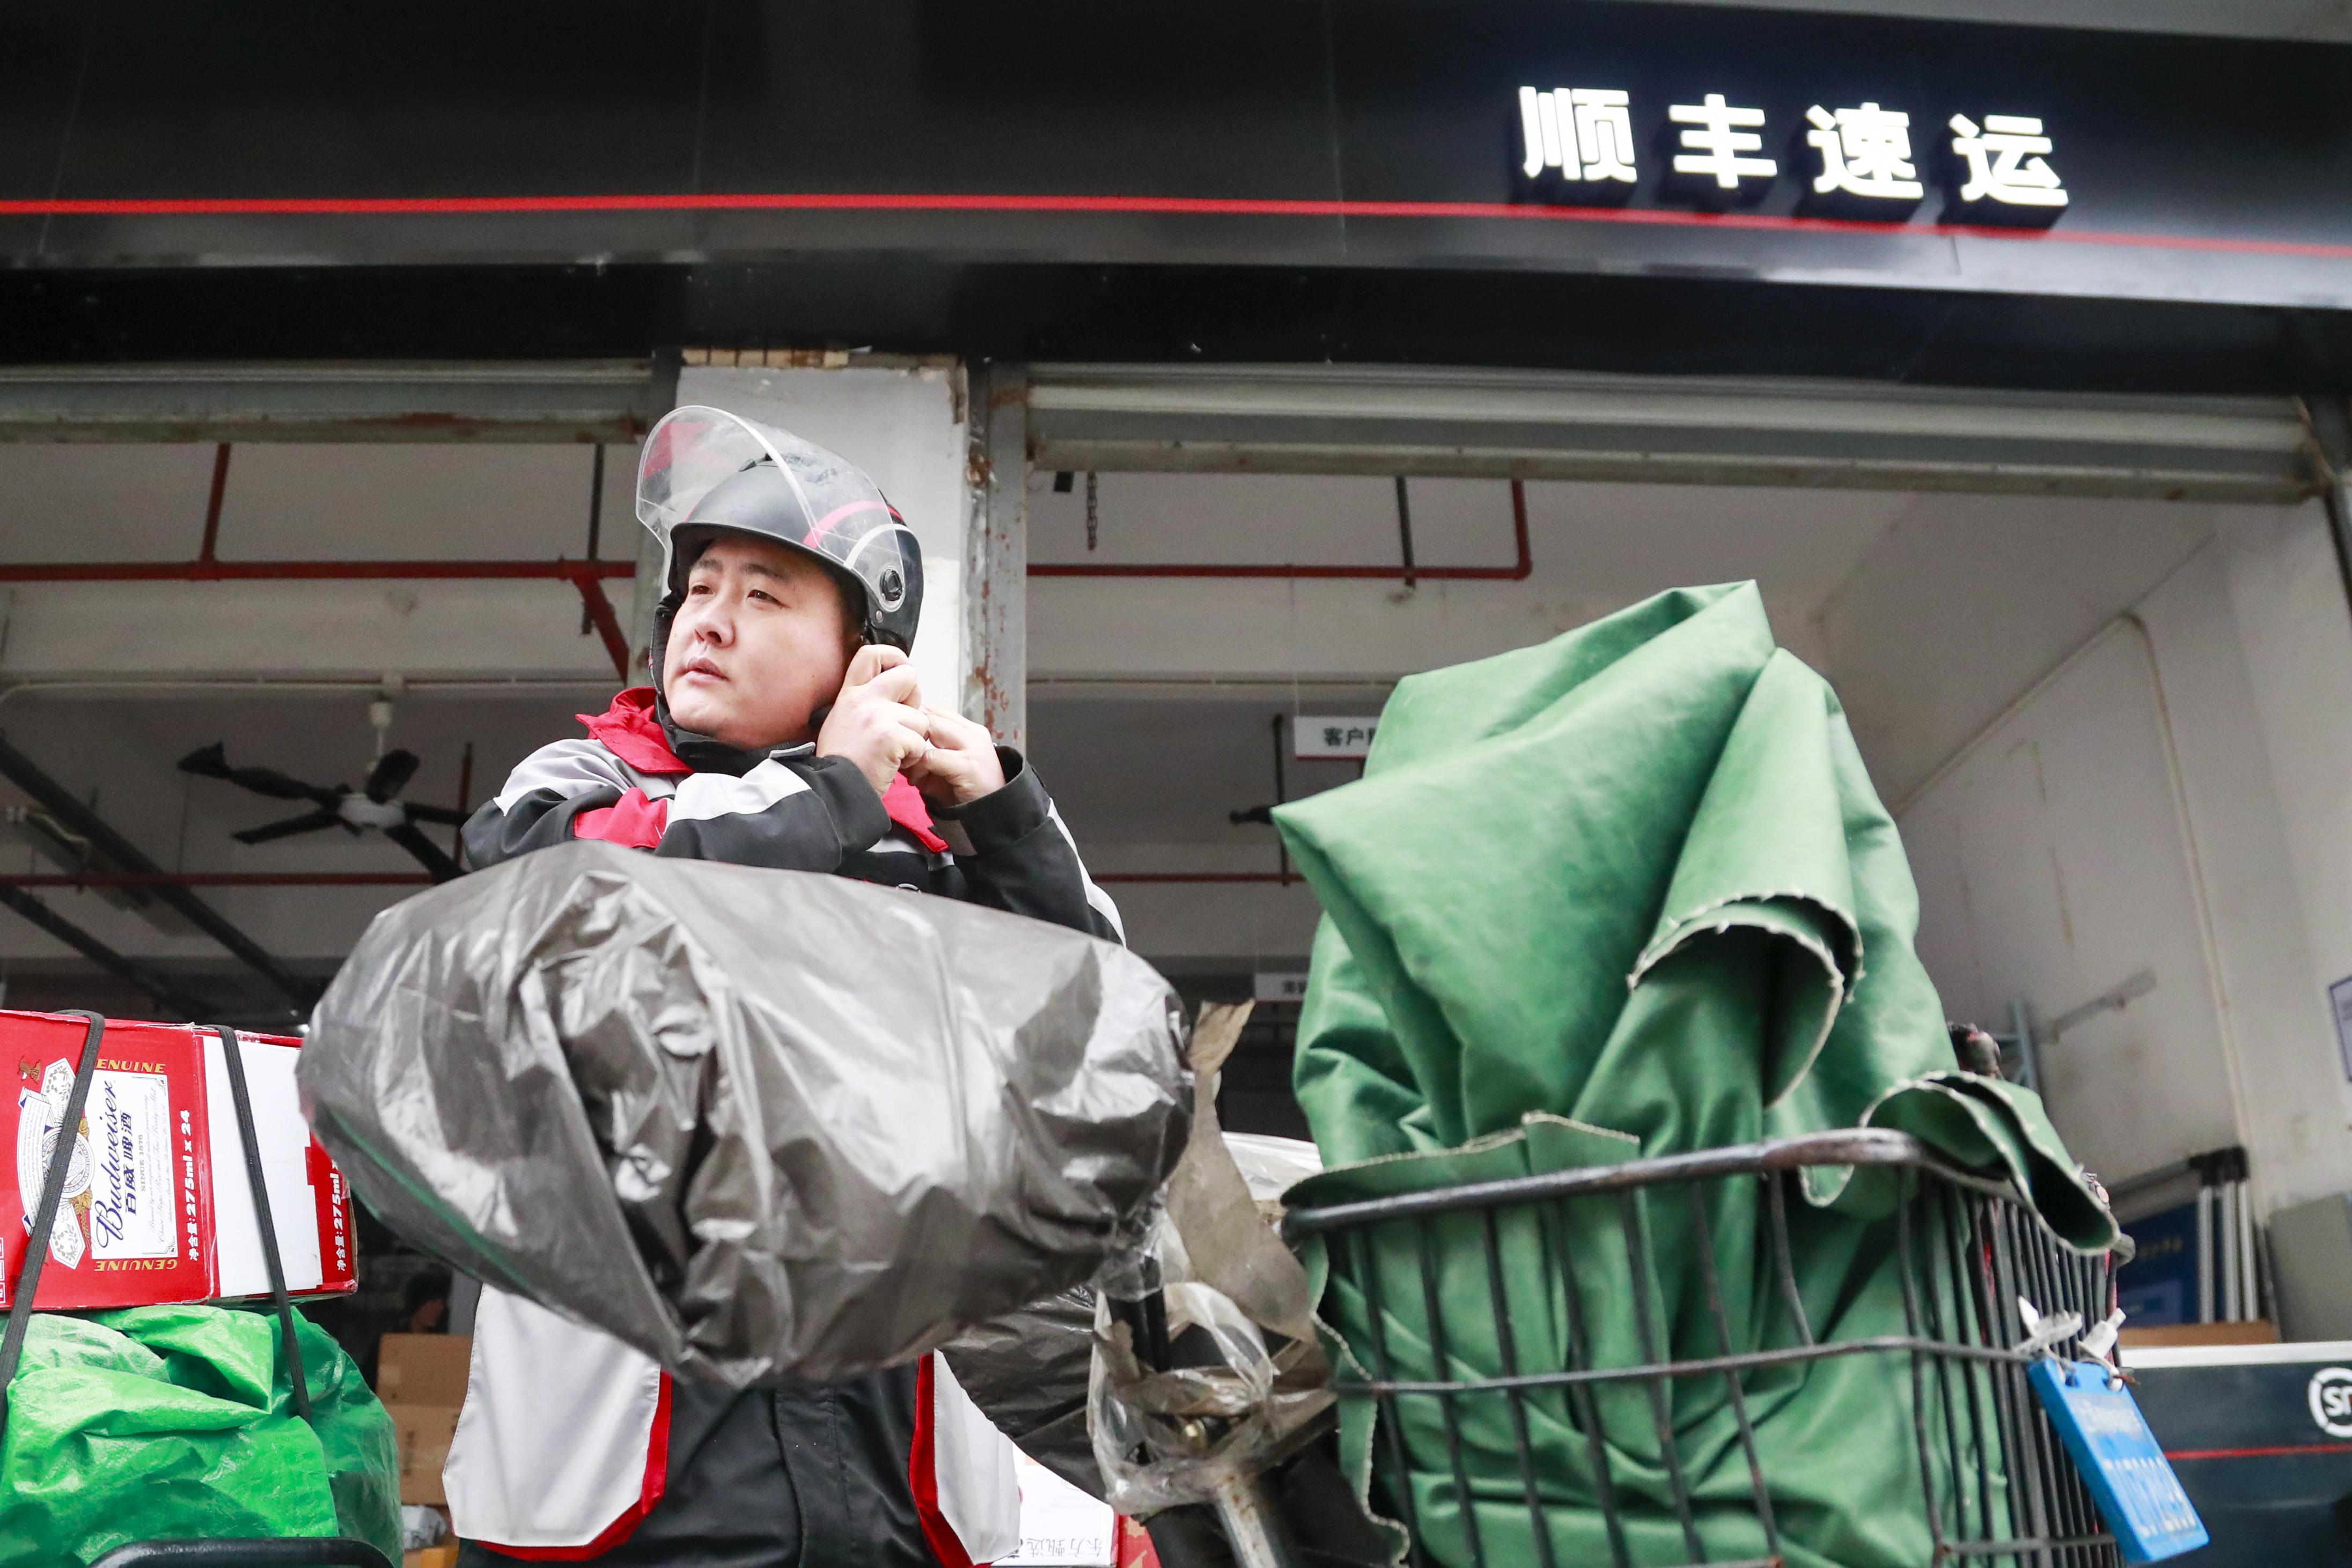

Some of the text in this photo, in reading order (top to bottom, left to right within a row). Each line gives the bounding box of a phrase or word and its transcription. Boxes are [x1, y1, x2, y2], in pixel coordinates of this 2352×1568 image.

[1519, 85, 2068, 206] 顺丰速运
[97, 1058, 165, 1073] ENUINE
[94, 1080, 124, 1248] Budweiser
[121, 1111, 136, 1214] 百威啤酒
[180, 1109, 191, 1136] 24
[182, 1155, 199, 1261] 净含量:275ml
[330, 1173, 346, 1271] 净含量:275ml
[94, 1259, 178, 1271] GENUINE
[1025, 1538, 1104, 1558] 东方甄选
